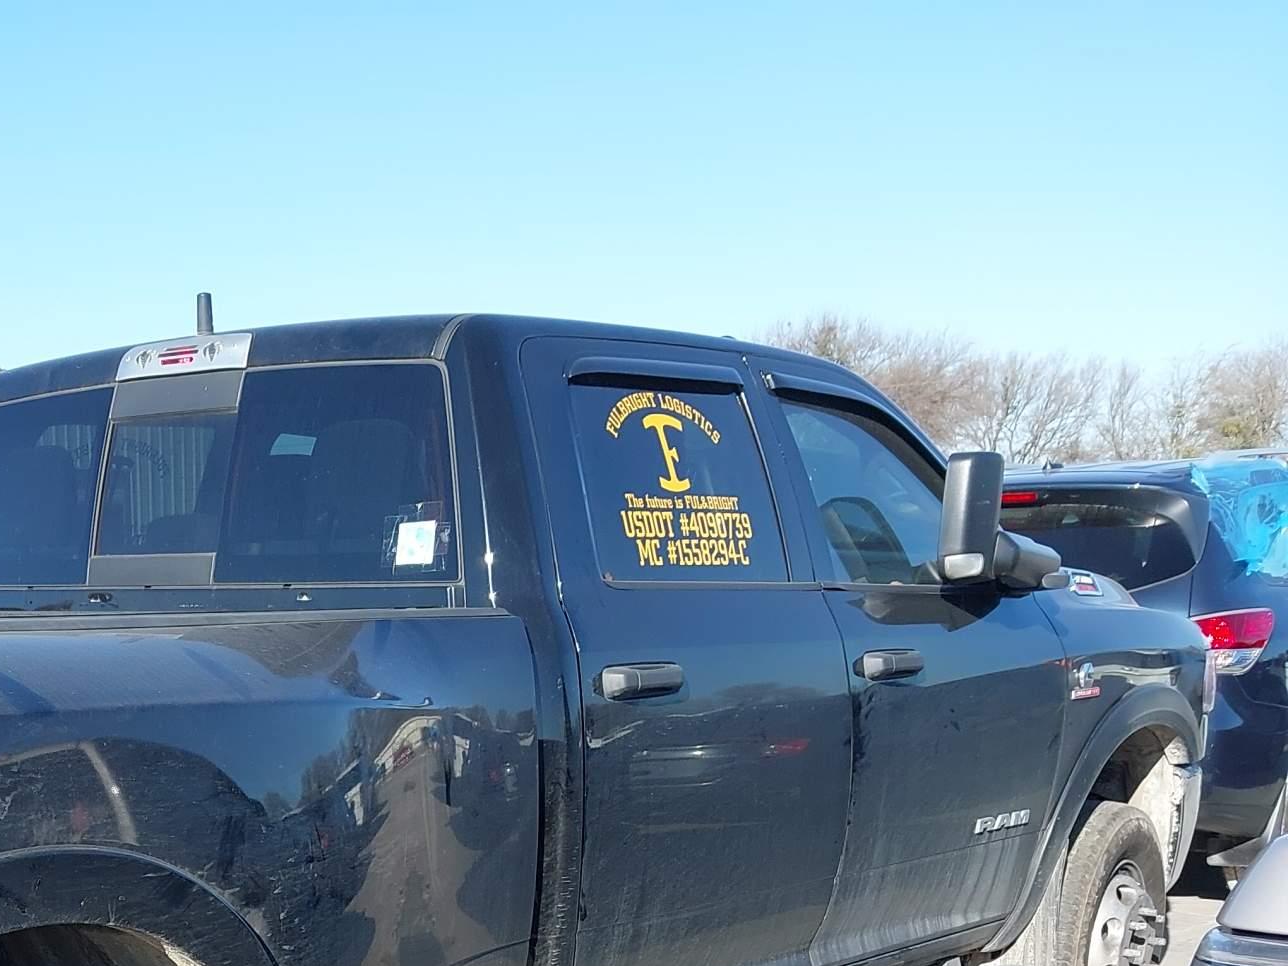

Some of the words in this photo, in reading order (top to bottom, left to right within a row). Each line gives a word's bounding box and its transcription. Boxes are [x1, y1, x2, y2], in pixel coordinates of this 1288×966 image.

[606, 392, 656, 438] FULBRIGHT
[657, 393, 721, 445] LOGISTICS
[624, 493, 644, 508] The
[645, 494, 673, 509] future
[674, 496, 684, 509] is
[684, 495, 738, 511] FUL&BRIGHT
[620, 510, 675, 538] USDOT
[679, 512, 753, 539] #4090739
[636, 539, 664, 566] MC
[666, 540, 750, 566] #1558294-C
[974, 809, 1030, 835] RAM
